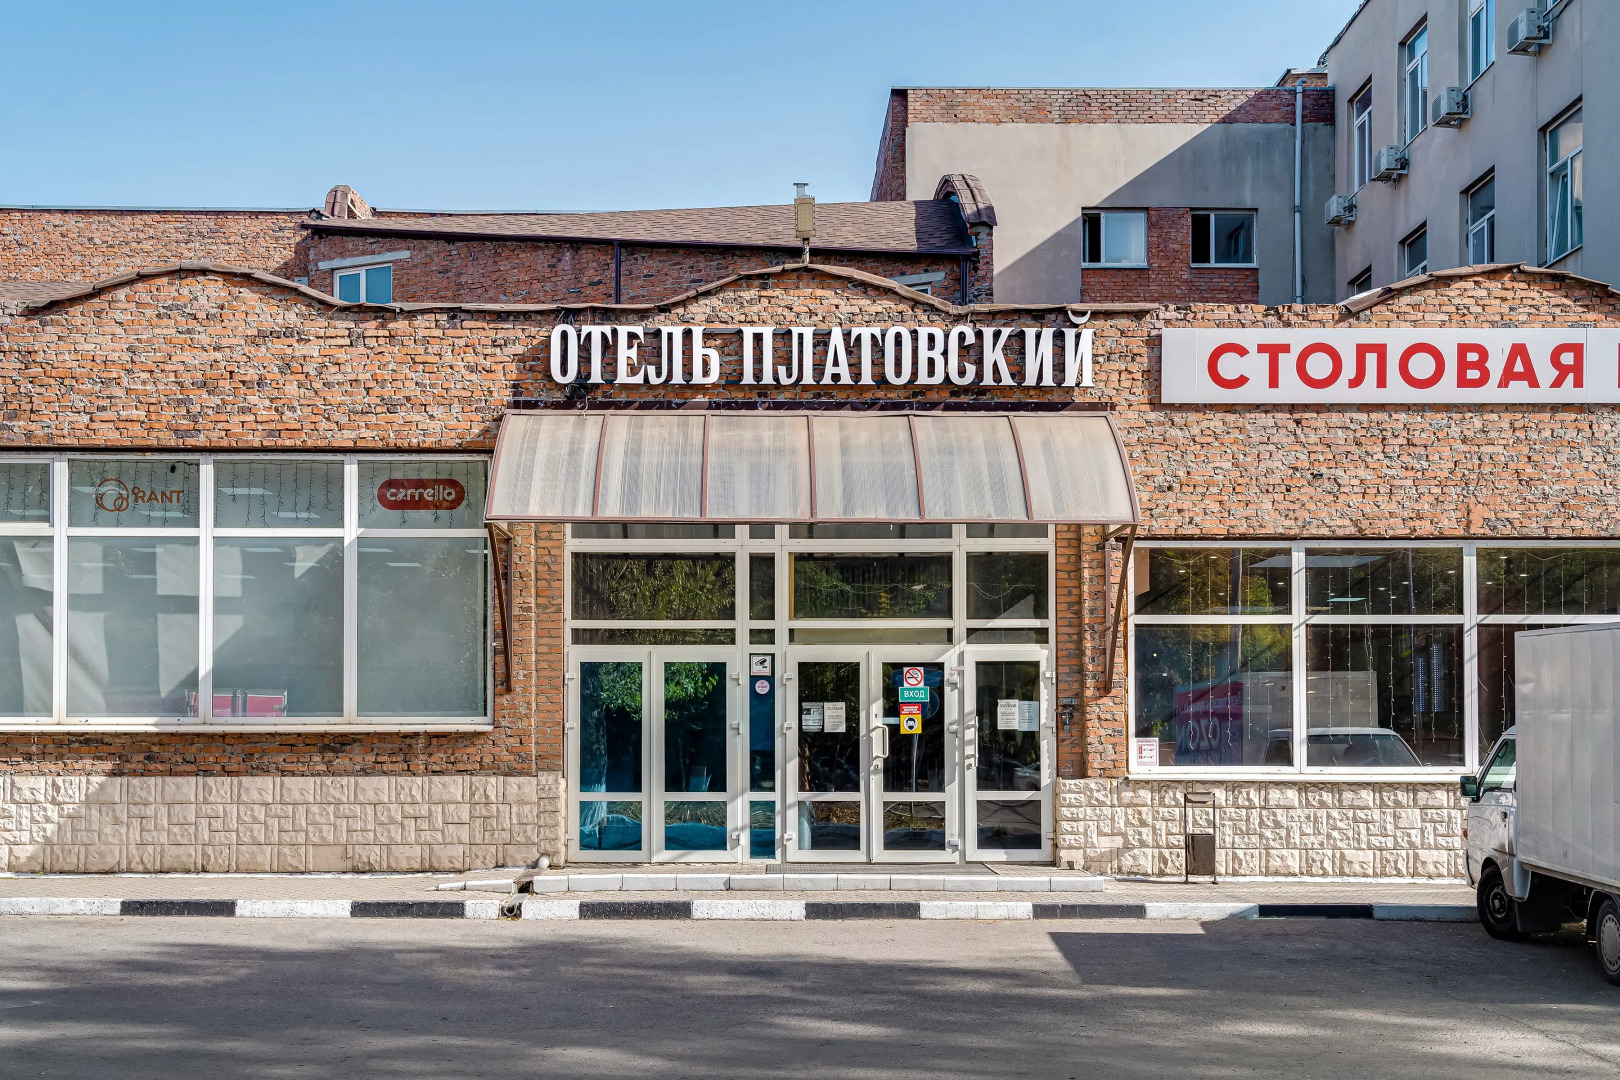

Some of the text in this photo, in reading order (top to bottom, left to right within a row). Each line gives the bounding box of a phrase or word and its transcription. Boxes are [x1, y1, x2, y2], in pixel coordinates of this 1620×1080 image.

[549, 310, 1094, 387] ОТЕЛЬ ПЛАТОВСКИЙ
[1207, 342, 1585, 389] СТОЛОВАЯ
[386, 485, 456, 501] carrello
[904, 690, 925, 698] ВХОД
